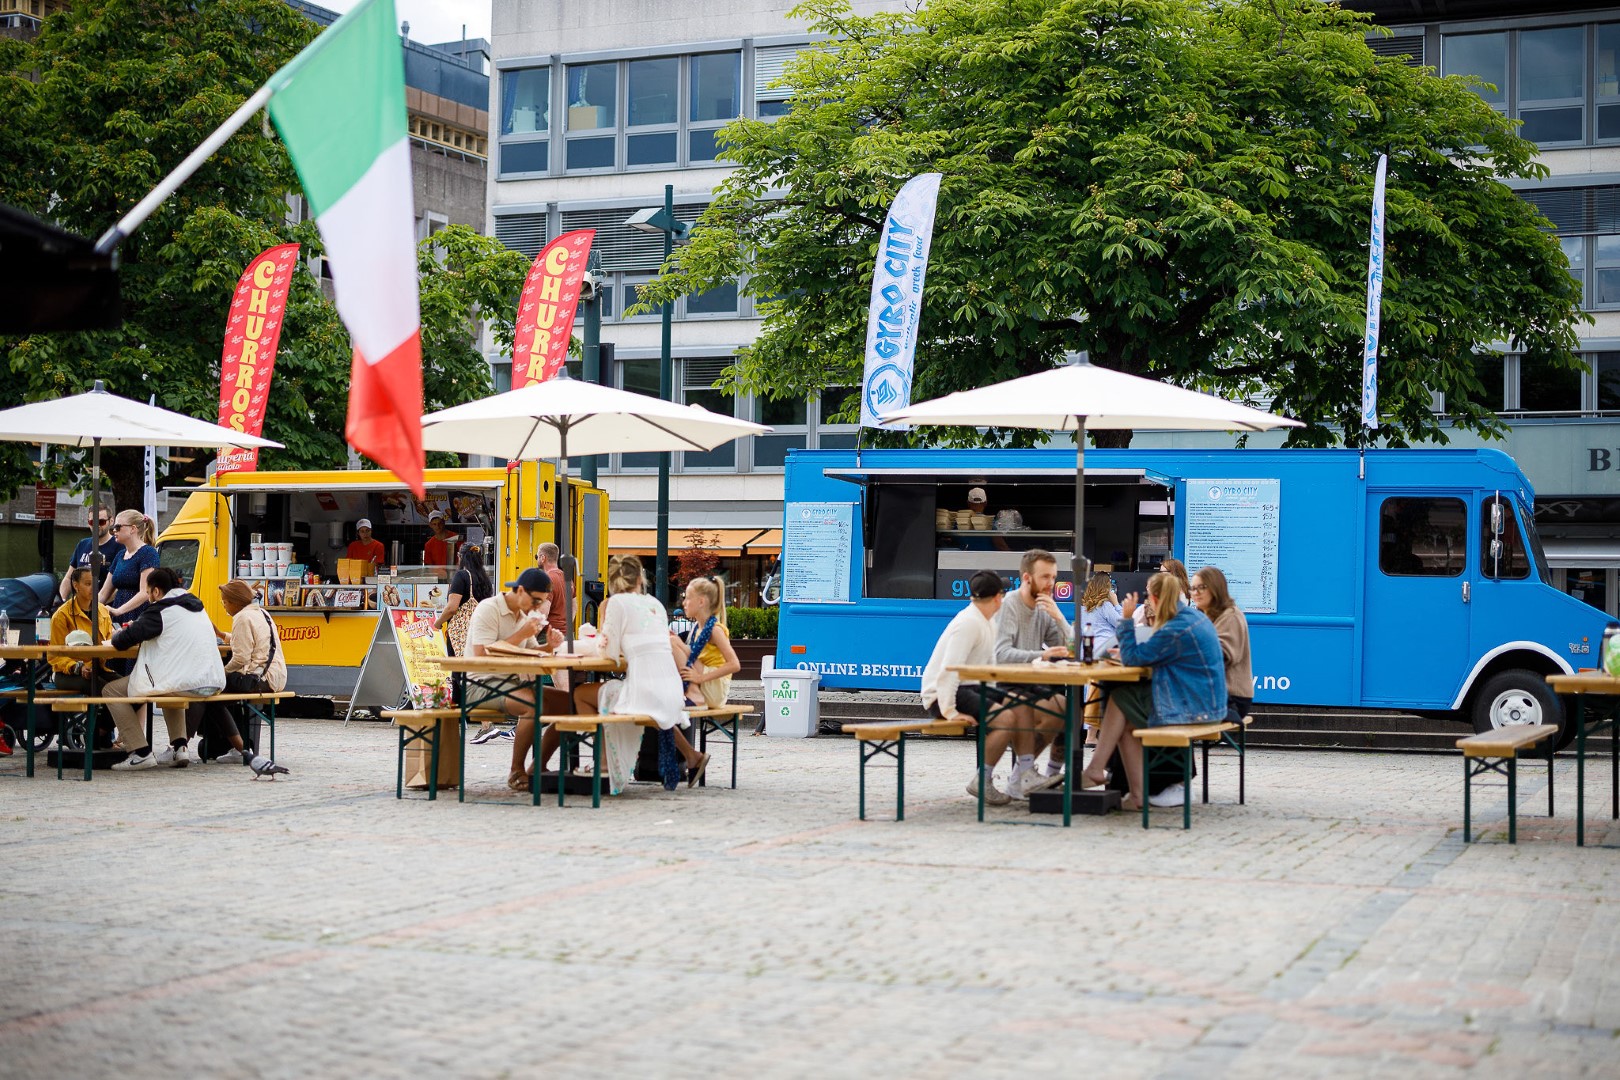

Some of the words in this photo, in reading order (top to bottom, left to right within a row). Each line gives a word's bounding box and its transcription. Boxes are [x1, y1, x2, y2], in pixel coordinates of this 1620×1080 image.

[885, 216, 913, 278] CITY
[523, 246, 569, 390] CHURR
[875, 284, 904, 359] GYRO
[229, 260, 276, 433] CHURROS
[1223, 486, 1242, 495] GYRO
[1243, 486, 1258, 495] CITY
[1534, 501, 1583, 517] XY
[338, 592, 359, 603] Coffee
[277, 624, 321, 641] hurros
[796, 661, 857, 675] ONLINE
[861, 664, 926, 678] BESTILL
[1252, 675, 1291, 690] y.no
[772, 689, 799, 699] PANT
